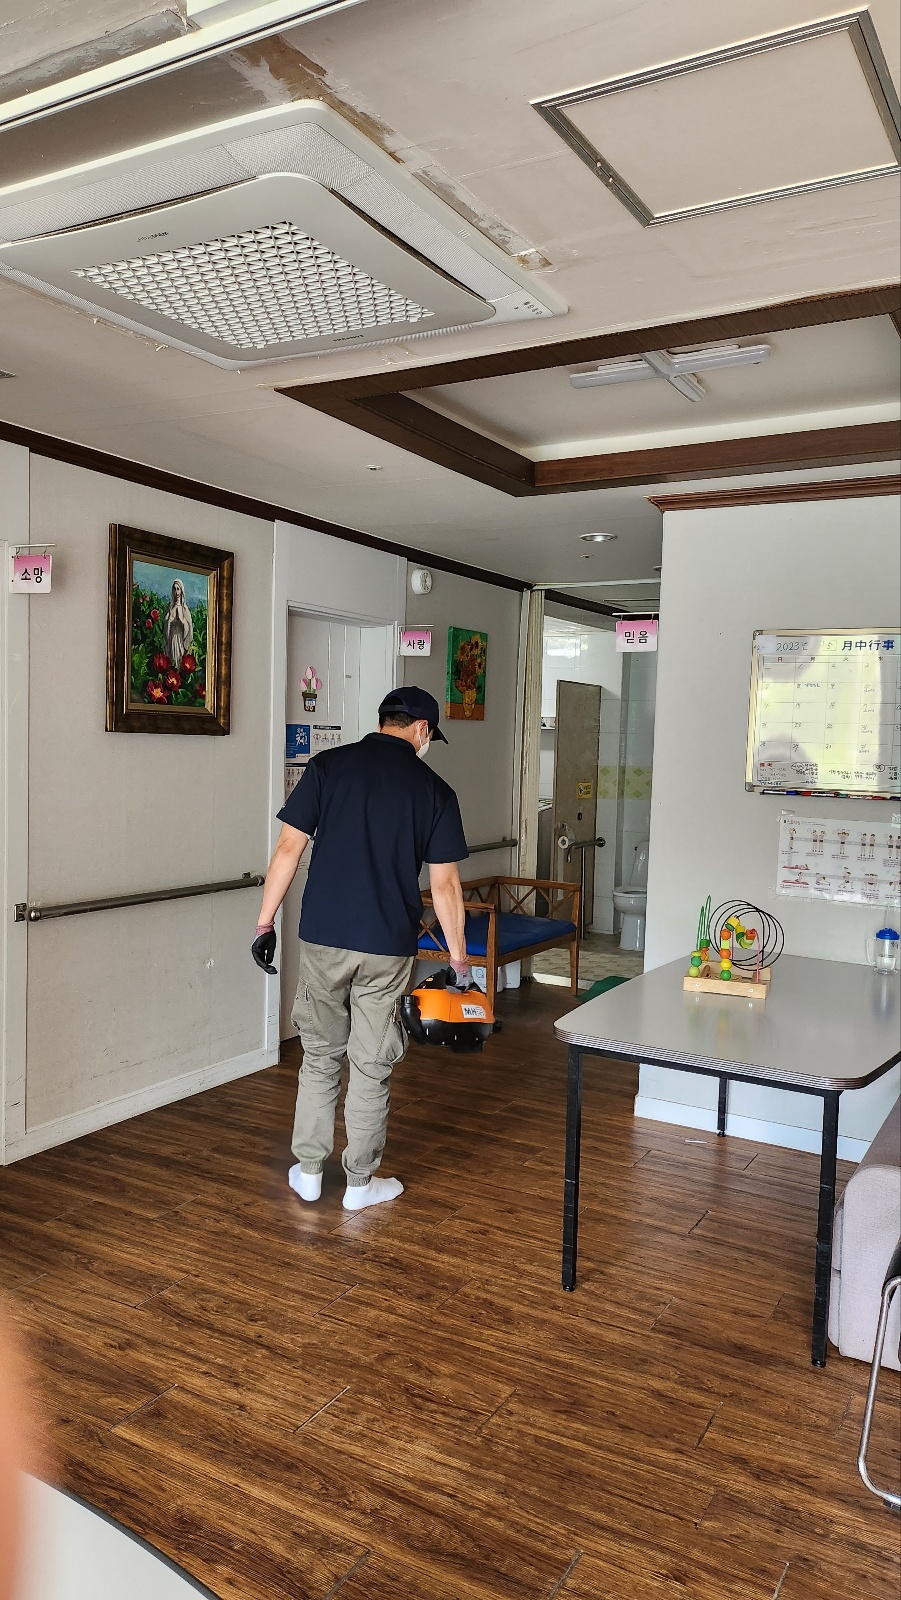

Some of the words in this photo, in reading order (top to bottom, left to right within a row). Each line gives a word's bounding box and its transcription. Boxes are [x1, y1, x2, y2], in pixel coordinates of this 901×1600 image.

[20, 566, 45, 584] 소망
[624, 630, 649, 644] 믿음
[406, 639, 426, 651] 사랑
[841, 639, 895, 651] 月中行事
